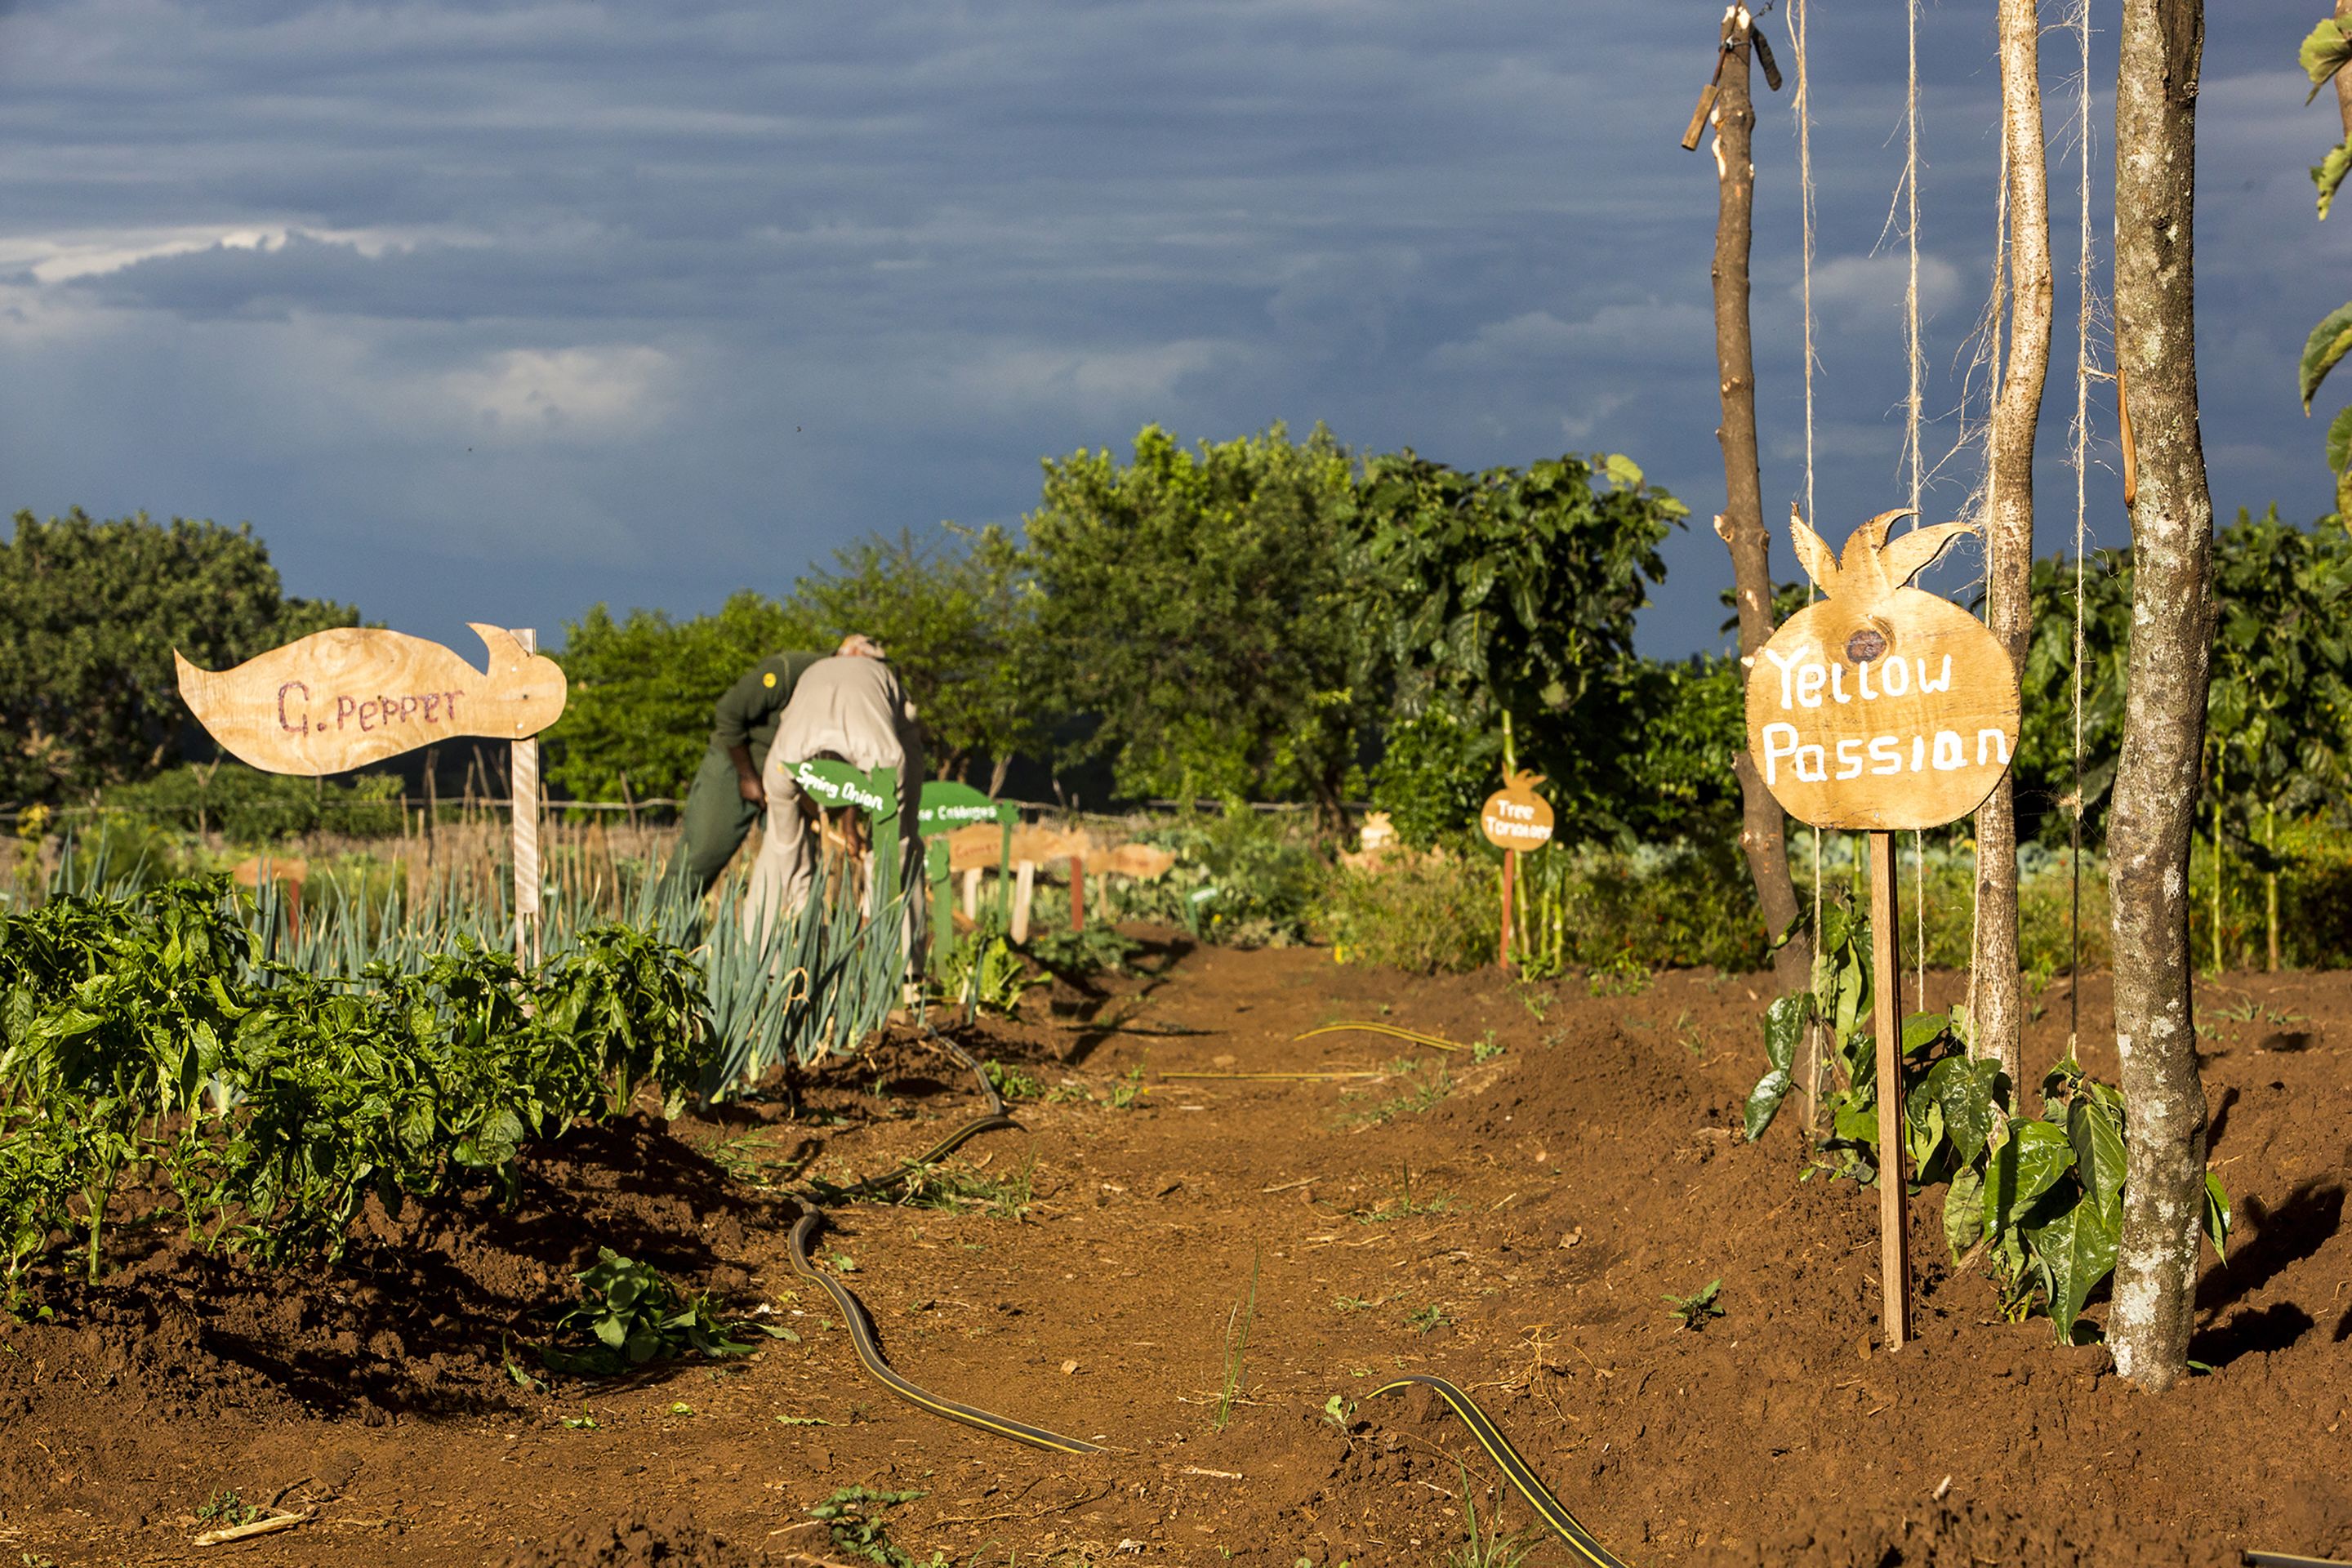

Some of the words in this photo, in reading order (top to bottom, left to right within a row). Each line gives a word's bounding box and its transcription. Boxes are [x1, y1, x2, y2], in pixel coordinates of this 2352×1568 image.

[1765, 645, 1952, 710] Yellow
[795, 762, 840, 799] Spring
[841, 782, 884, 811] Onion
[1496, 799, 1535, 820] Tree
